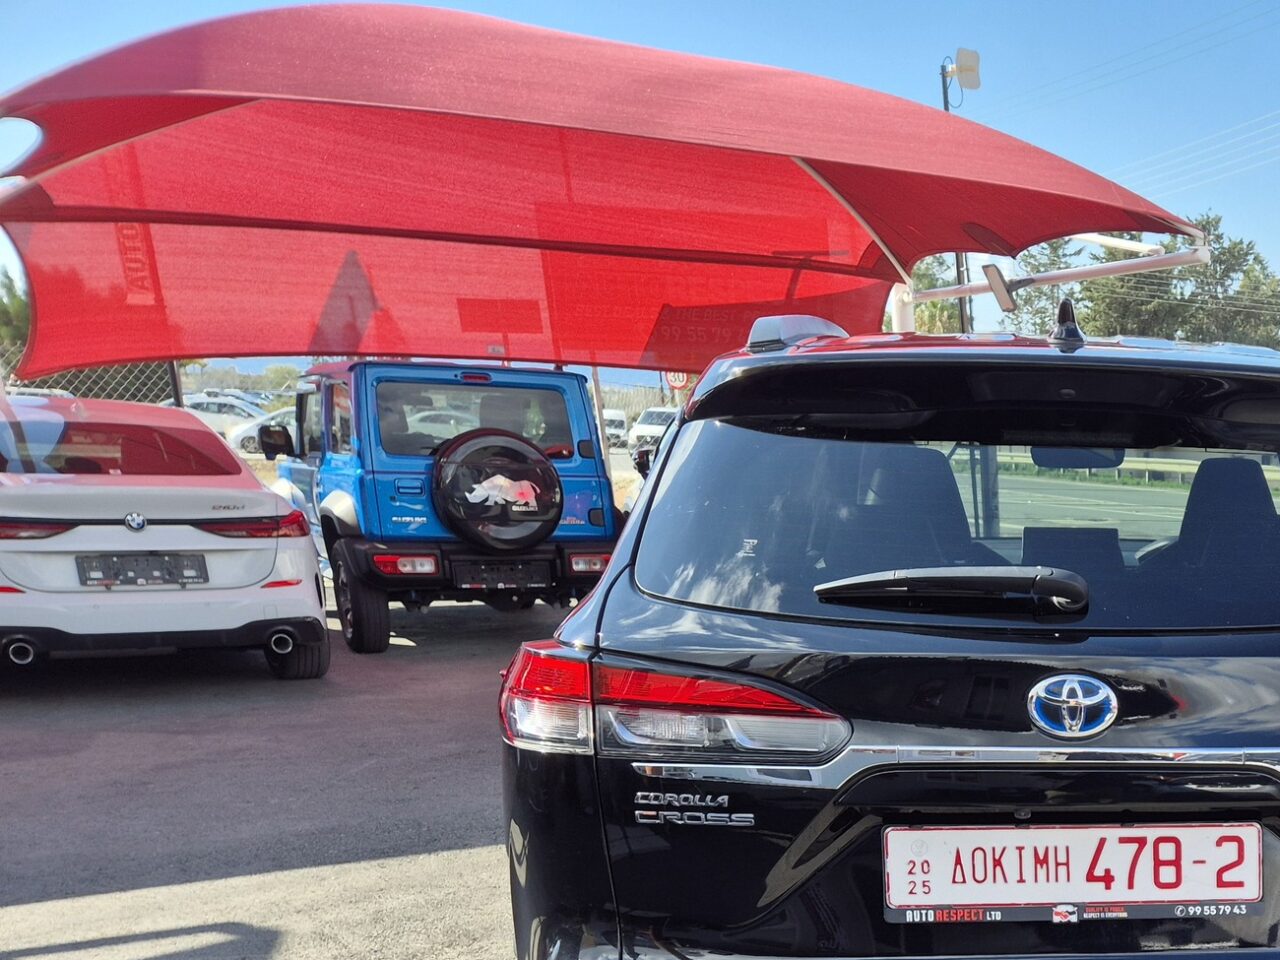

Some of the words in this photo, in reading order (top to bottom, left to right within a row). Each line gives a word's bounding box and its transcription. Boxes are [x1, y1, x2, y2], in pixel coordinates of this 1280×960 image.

[634, 791, 729, 808] COROLLA
[634, 810, 755, 826] CROSS
[907, 859, 931, 875] 20
[951, 845, 1071, 884] ΔΟΚΙΜΗ
[1086, 834, 1245, 890] 478-2
[908, 880, 931, 895] 25
[986, 911, 1002, 920] LTD
[1188, 906, 1201, 916] 99
[1203, 905, 1217, 915] 55
[1218, 905, 1231, 915] 79
[1232, 904, 1247, 915] 43
